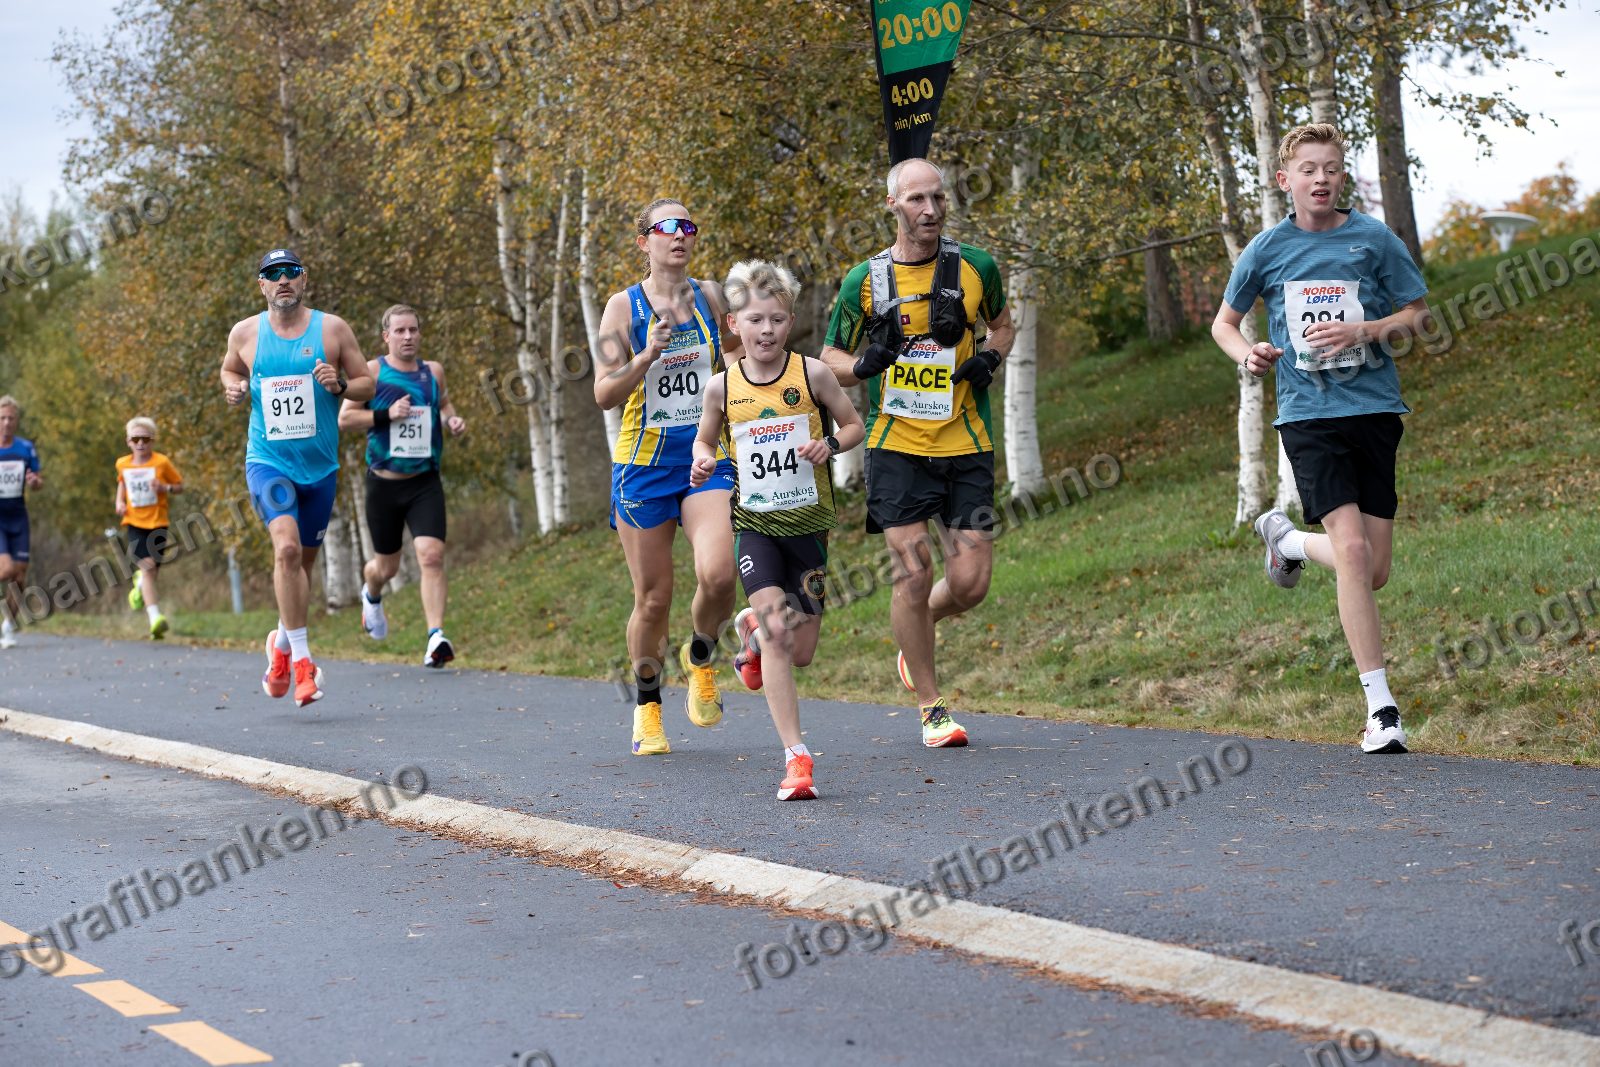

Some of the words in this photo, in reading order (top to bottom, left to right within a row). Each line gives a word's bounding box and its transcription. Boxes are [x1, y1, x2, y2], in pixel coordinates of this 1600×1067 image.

[879, 2, 962, 49] 20:00
[891, 78, 934, 107] 4:00
[1300, 286, 1347, 296] NORGES
[1306, 295, 1341, 304] LØPET
[661, 352, 700, 366] NORGES
[665, 360, 695, 371] LØPET
[658, 371, 699, 398] 840
[893, 365, 948, 389] PACE
[271, 396, 305, 417] 912
[911, 400, 950, 413] Aurskog
[399, 423, 423, 439] 251
[749, 423, 796, 436] NORGES
[753, 432, 789, 444] LØPET
[750, 448, 799, 480] 344
[772, 486, 815, 501] Aurskog
